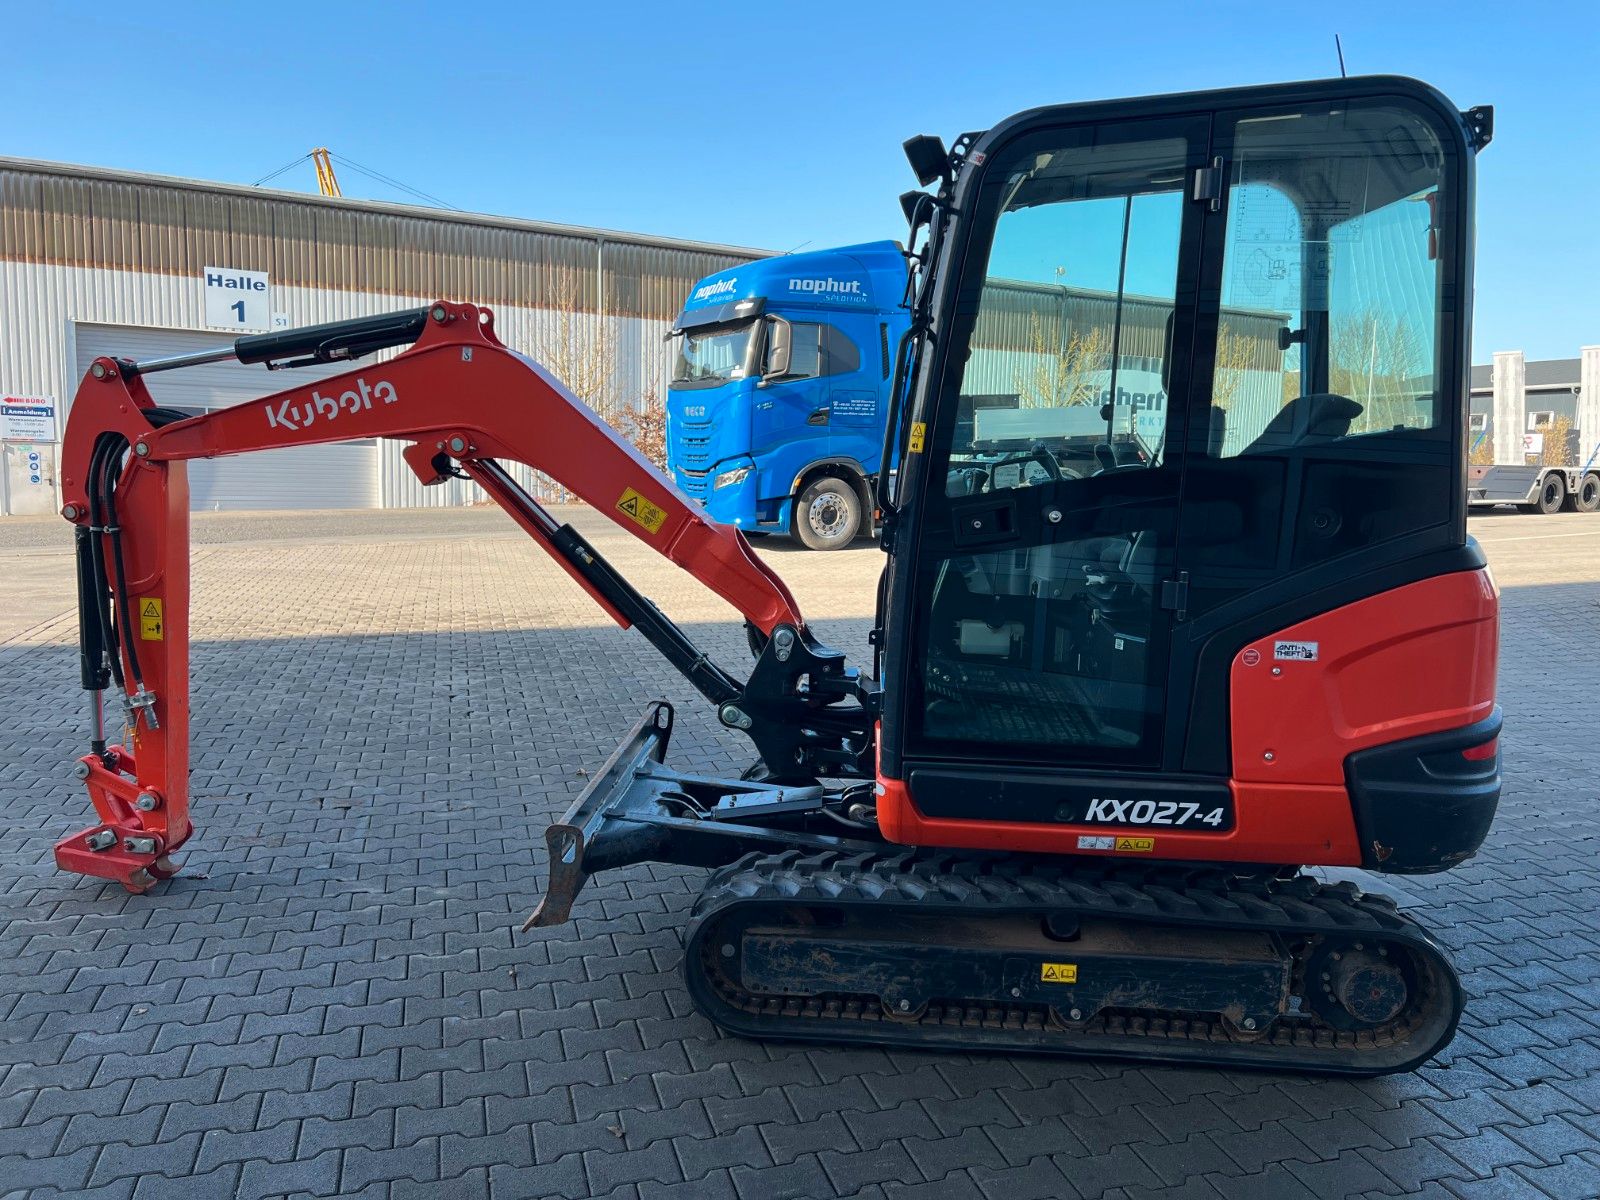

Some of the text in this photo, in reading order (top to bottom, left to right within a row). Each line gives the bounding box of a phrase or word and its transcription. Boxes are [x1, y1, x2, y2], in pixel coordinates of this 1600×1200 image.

[207, 274, 266, 291] Halle
[694, 277, 737, 300] nophut
[788, 277, 861, 295] nophut
[823, 294, 867, 303] SPEDITION
[231, 300, 246, 323] 1
[275, 318, 287, 327] S1
[8, 408, 48, 417] Anmeldung
[265, 378, 398, 431] Kubota
[1084, 798, 1225, 827] KX027-4
